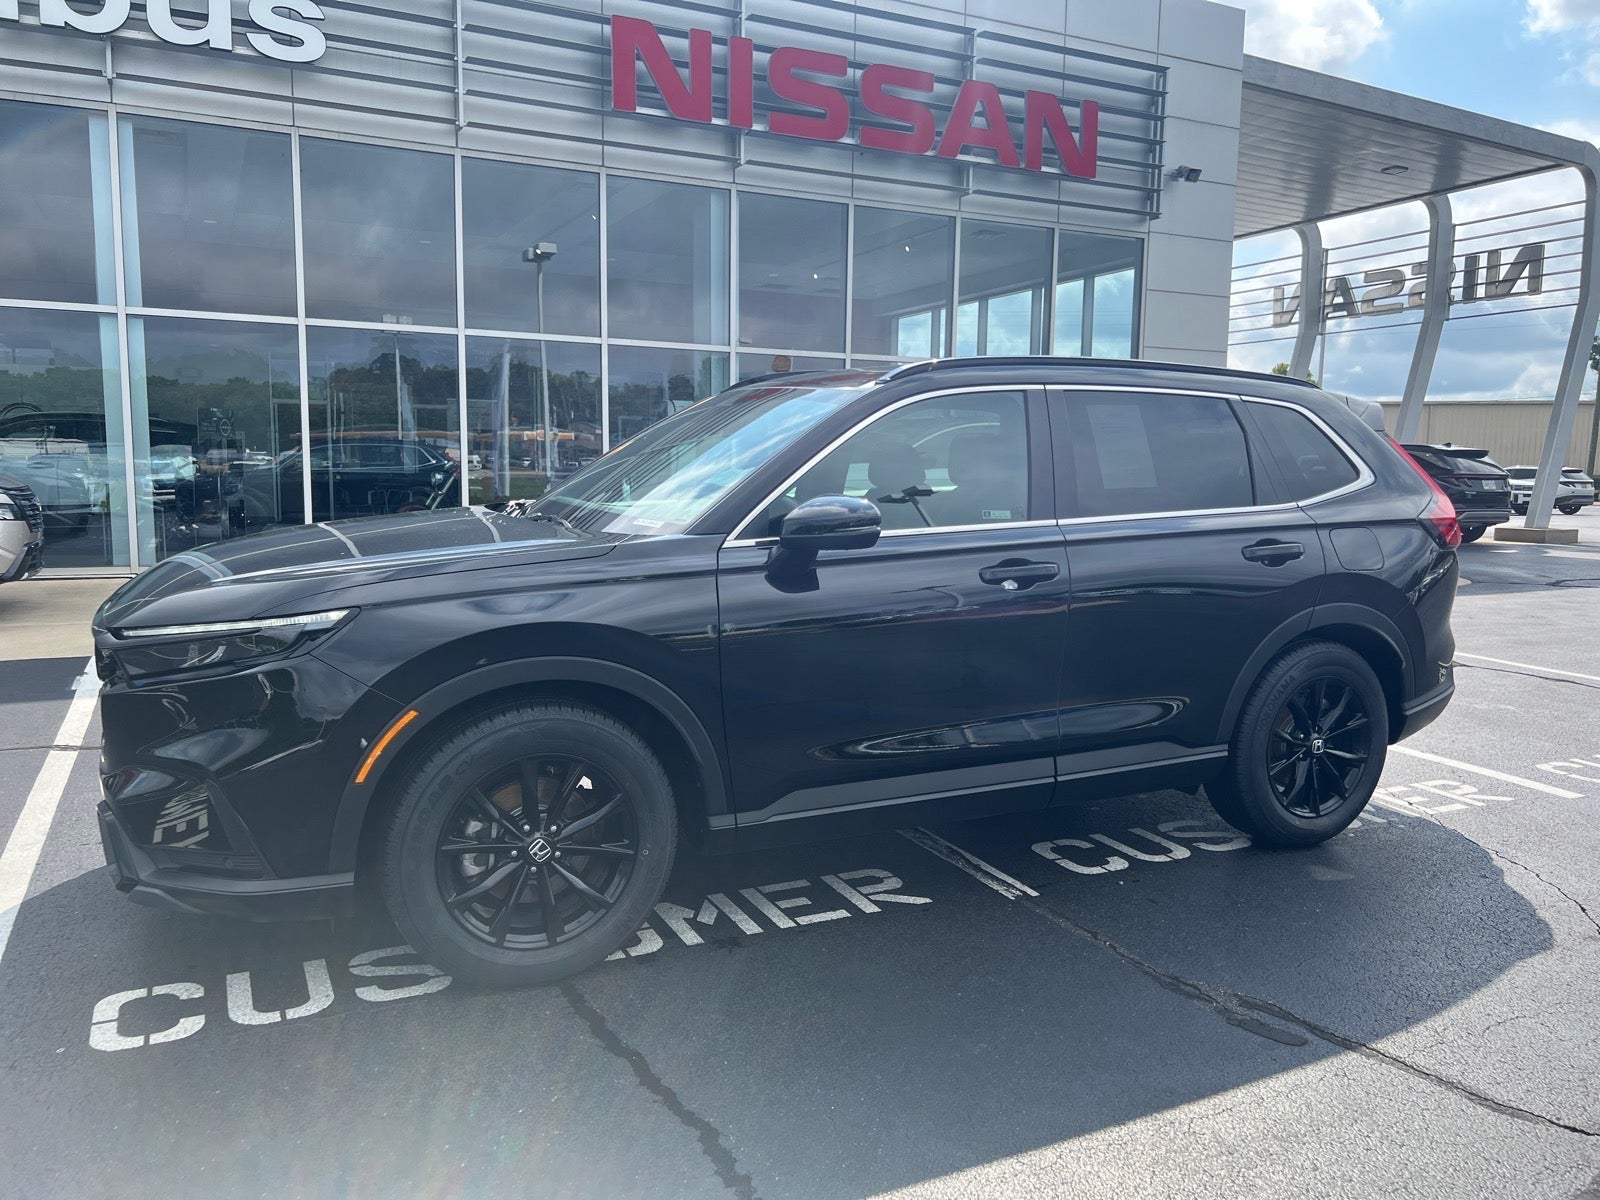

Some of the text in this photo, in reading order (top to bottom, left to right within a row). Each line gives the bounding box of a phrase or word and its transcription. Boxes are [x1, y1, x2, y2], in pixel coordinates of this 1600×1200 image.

[611, 15, 1098, 179] NISSAN
[1031, 779, 1515, 874] CUSMER
[89, 868, 933, 1051] CUSMER
